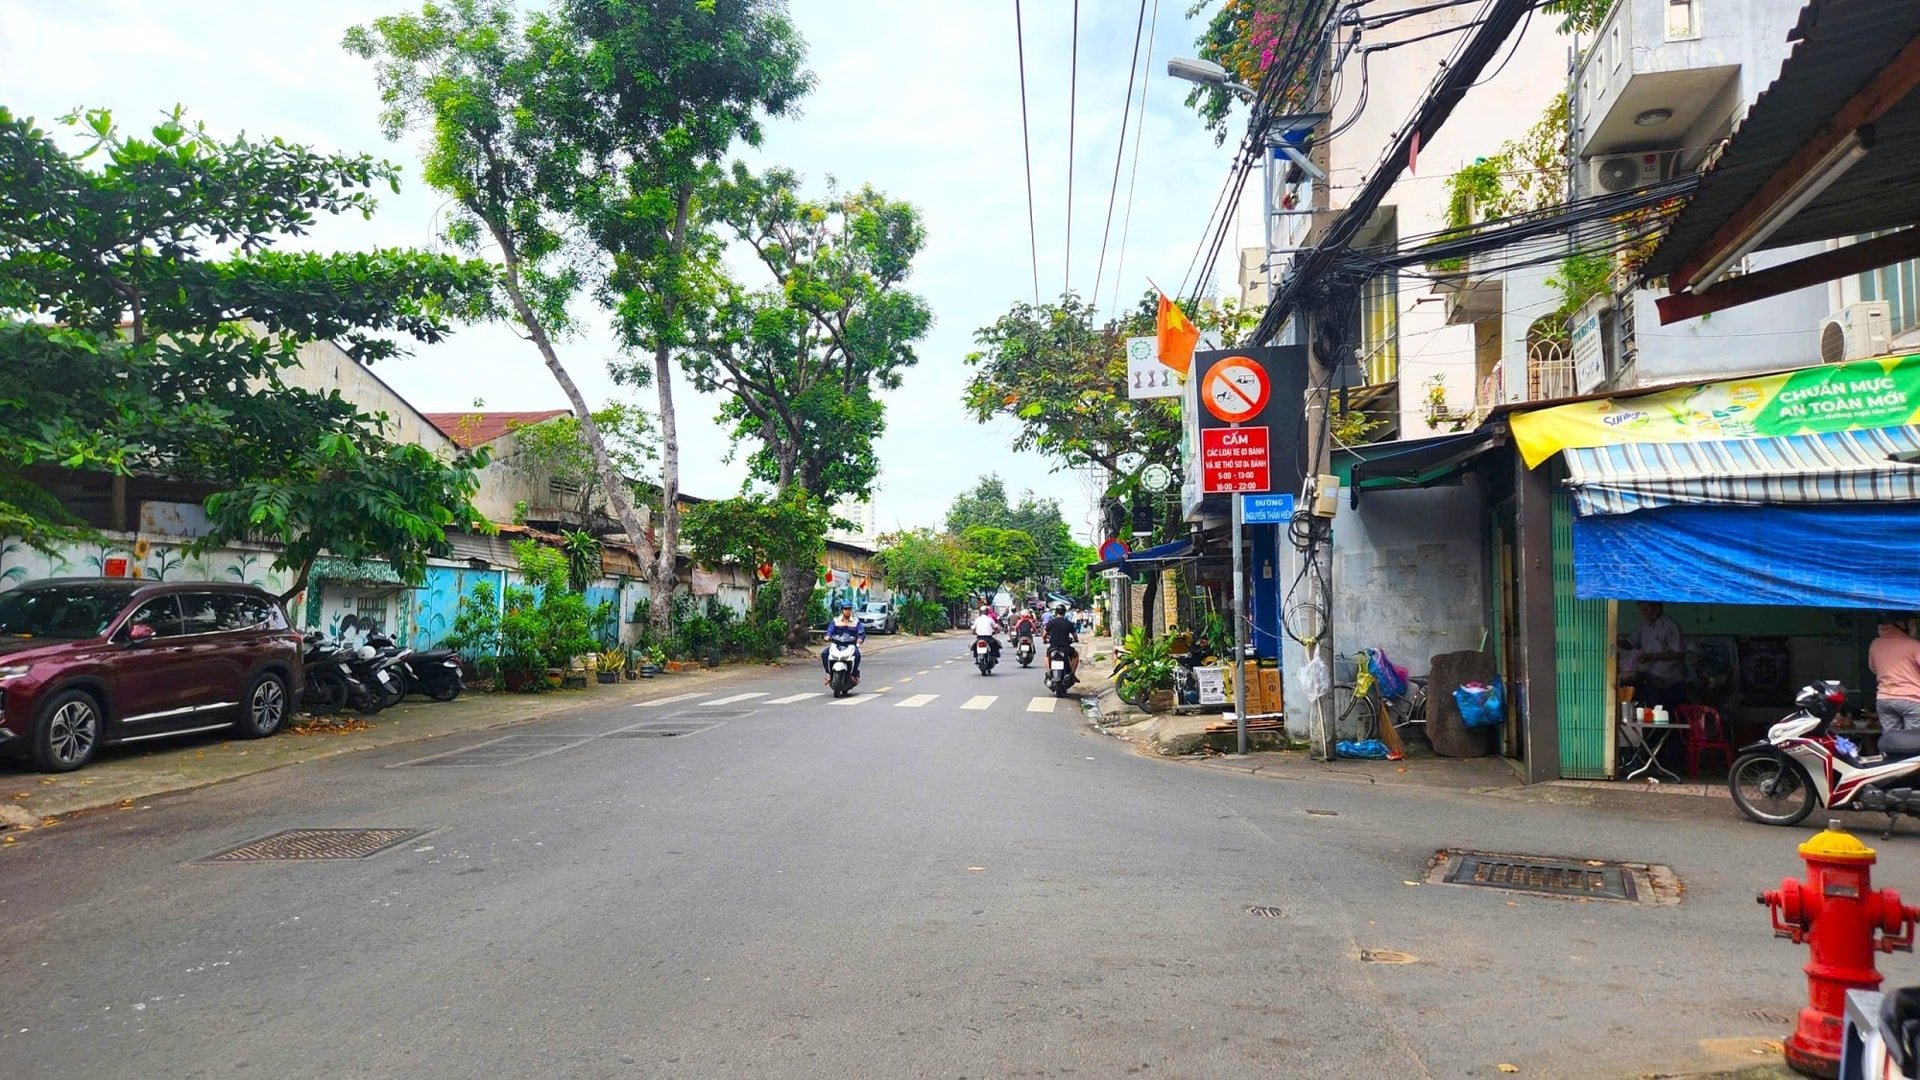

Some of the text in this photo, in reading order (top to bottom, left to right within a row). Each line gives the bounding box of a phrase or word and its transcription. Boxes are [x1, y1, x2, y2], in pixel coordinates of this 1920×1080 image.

[1779, 378, 1846, 403] CHUẨN
[1850, 377, 1895, 393] MỰC
[1779, 390, 1908, 417] AN TOÀN MỚI
[1223, 431, 1249, 445] CẤM
[1233, 447, 1240, 456] XE
[1248, 446, 1265, 456] BÁNH
[1205, 459, 1214, 469] VÀ
[1214, 460, 1221, 469] XE
[1222, 459, 1233, 469] THÔ
[1250, 457, 1267, 468] BÁNH
[1218, 472, 1232, 480] 5:00
[1238, 482, 1256, 490] 22:00
[1255, 498, 1284, 507] ĐƯỜNG
